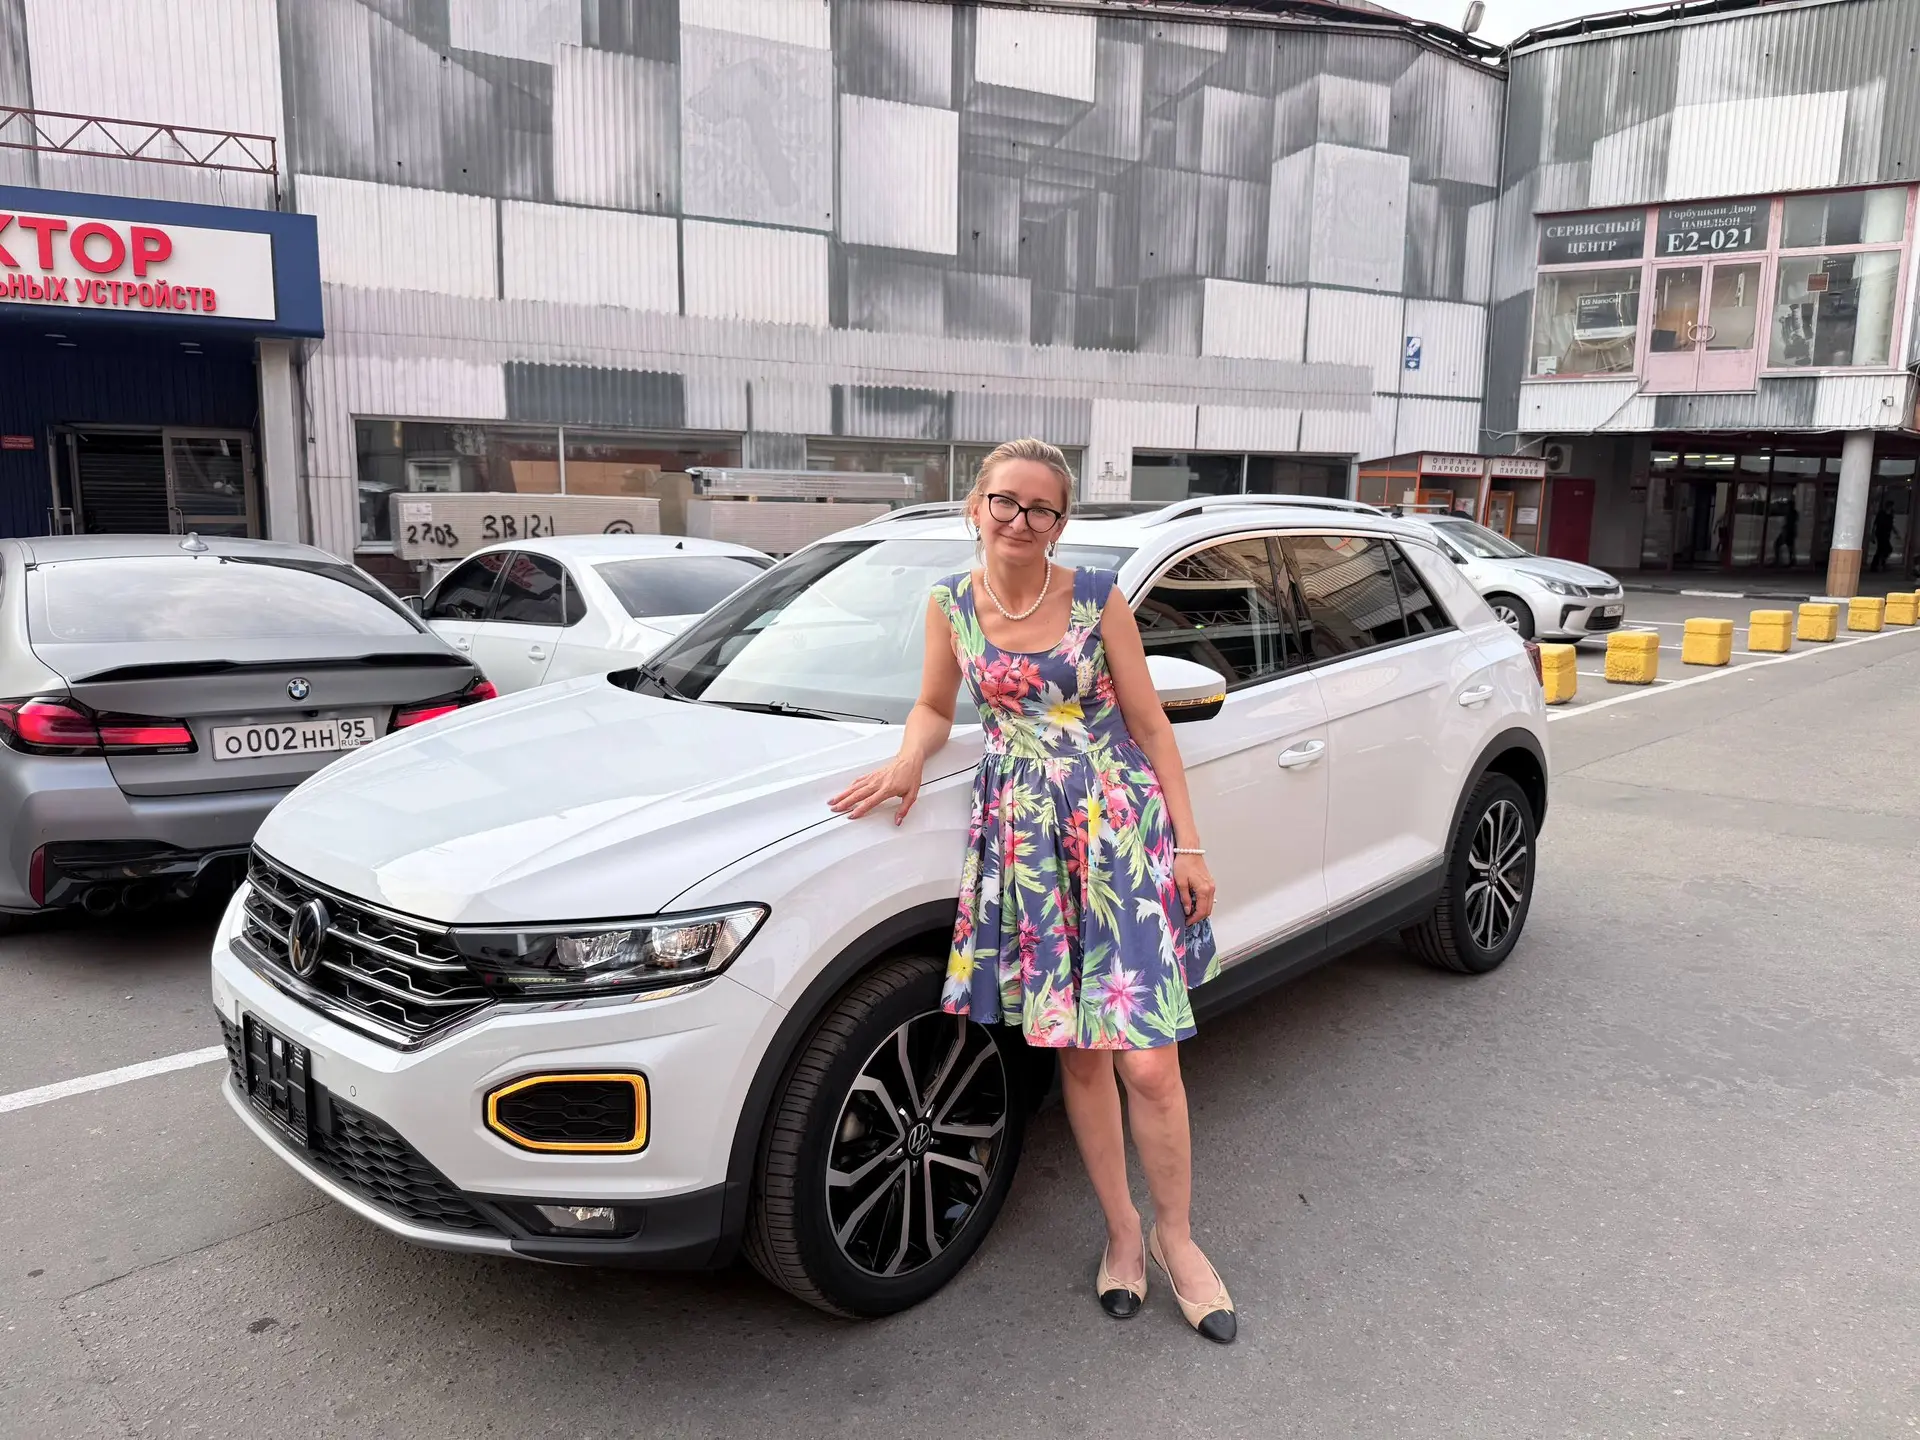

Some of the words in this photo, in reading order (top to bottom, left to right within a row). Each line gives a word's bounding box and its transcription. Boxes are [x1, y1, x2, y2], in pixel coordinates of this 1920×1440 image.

[1668, 206, 1727, 219] Горбушкин
[1728, 204, 1757, 215] Двор
[1546, 218, 1642, 238] СЕРВИСНЫЙ
[1681, 216, 1741, 230] ПАВИЛЬОН
[1567, 240, 1617, 255] ЦЕНТР
[74, 277, 217, 313] УСТРОЙСТВ
[1581, 298, 1591, 306] LG
[1432, 457, 1477, 466] ОПЛАТА
[1431, 465, 1477, 473] ПАРКОВКИ
[1500, 467, 1539, 475] ПАРКОВКИ
[407, 522, 459, 548] 27.03
[340, 720, 366, 739] 95
[341, 738, 360, 747] RUS
